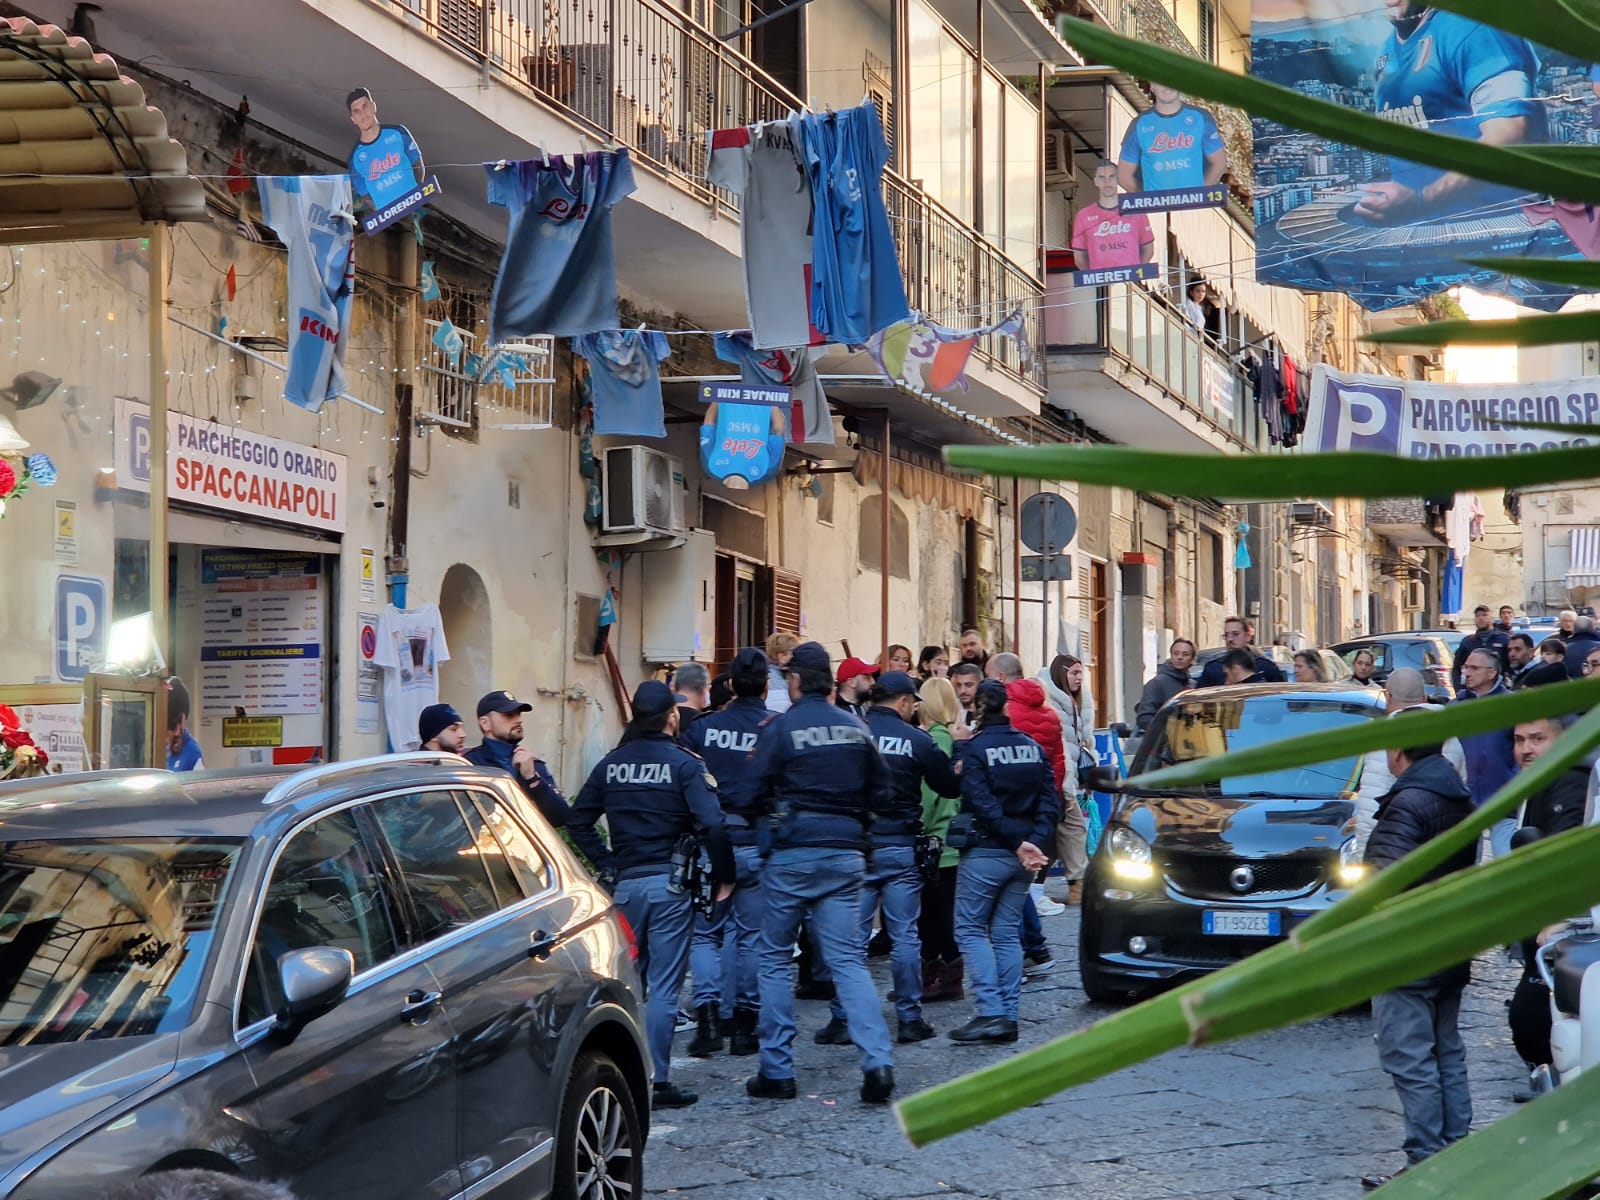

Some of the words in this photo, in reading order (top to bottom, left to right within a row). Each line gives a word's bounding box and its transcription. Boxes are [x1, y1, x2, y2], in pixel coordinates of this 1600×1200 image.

[1148, 132, 1194, 153] Lete
[368, 152, 400, 180] Lete
[1165, 158, 1191, 170] MSC
[366, 218, 378, 230] DI
[378, 191, 423, 224] LORENZO
[422, 183, 436, 196] 22
[1122, 192, 1204, 210] A.RRAHMANI
[1207, 191, 1223, 201] 13
[1093, 221, 1131, 237] Lete
[1108, 241, 1128, 249] MSC
[1083, 269, 1132, 285] MERET
[1136, 268, 1144, 279] 1
[703, 387, 712, 397] 3
[717, 388, 740, 399] KIM
[743, 389, 789, 403] MINJAE
[1336, 389, 1387, 452] P
[1411, 394, 1561, 432] PARCHEGGIO
[1567, 392, 1600, 425] SP
[178, 423, 279, 468] PARCHEGGIO
[284, 450, 337, 482] ORARIO
[722, 438, 766, 459] Lete
[175, 457, 337, 521] SPACCANAPOLI
[66, 592, 96, 667] P
[217, 648, 249, 657] TARIFFE
[704, 728, 759, 752] POLIZ
[790, 726, 867, 750] POLIZIA
[870, 735, 914, 758] IZIA
[985, 745, 1043, 767] POLIZIA
[606, 763, 673, 784] POLIZIA
[1214, 916, 1228, 930] FT
